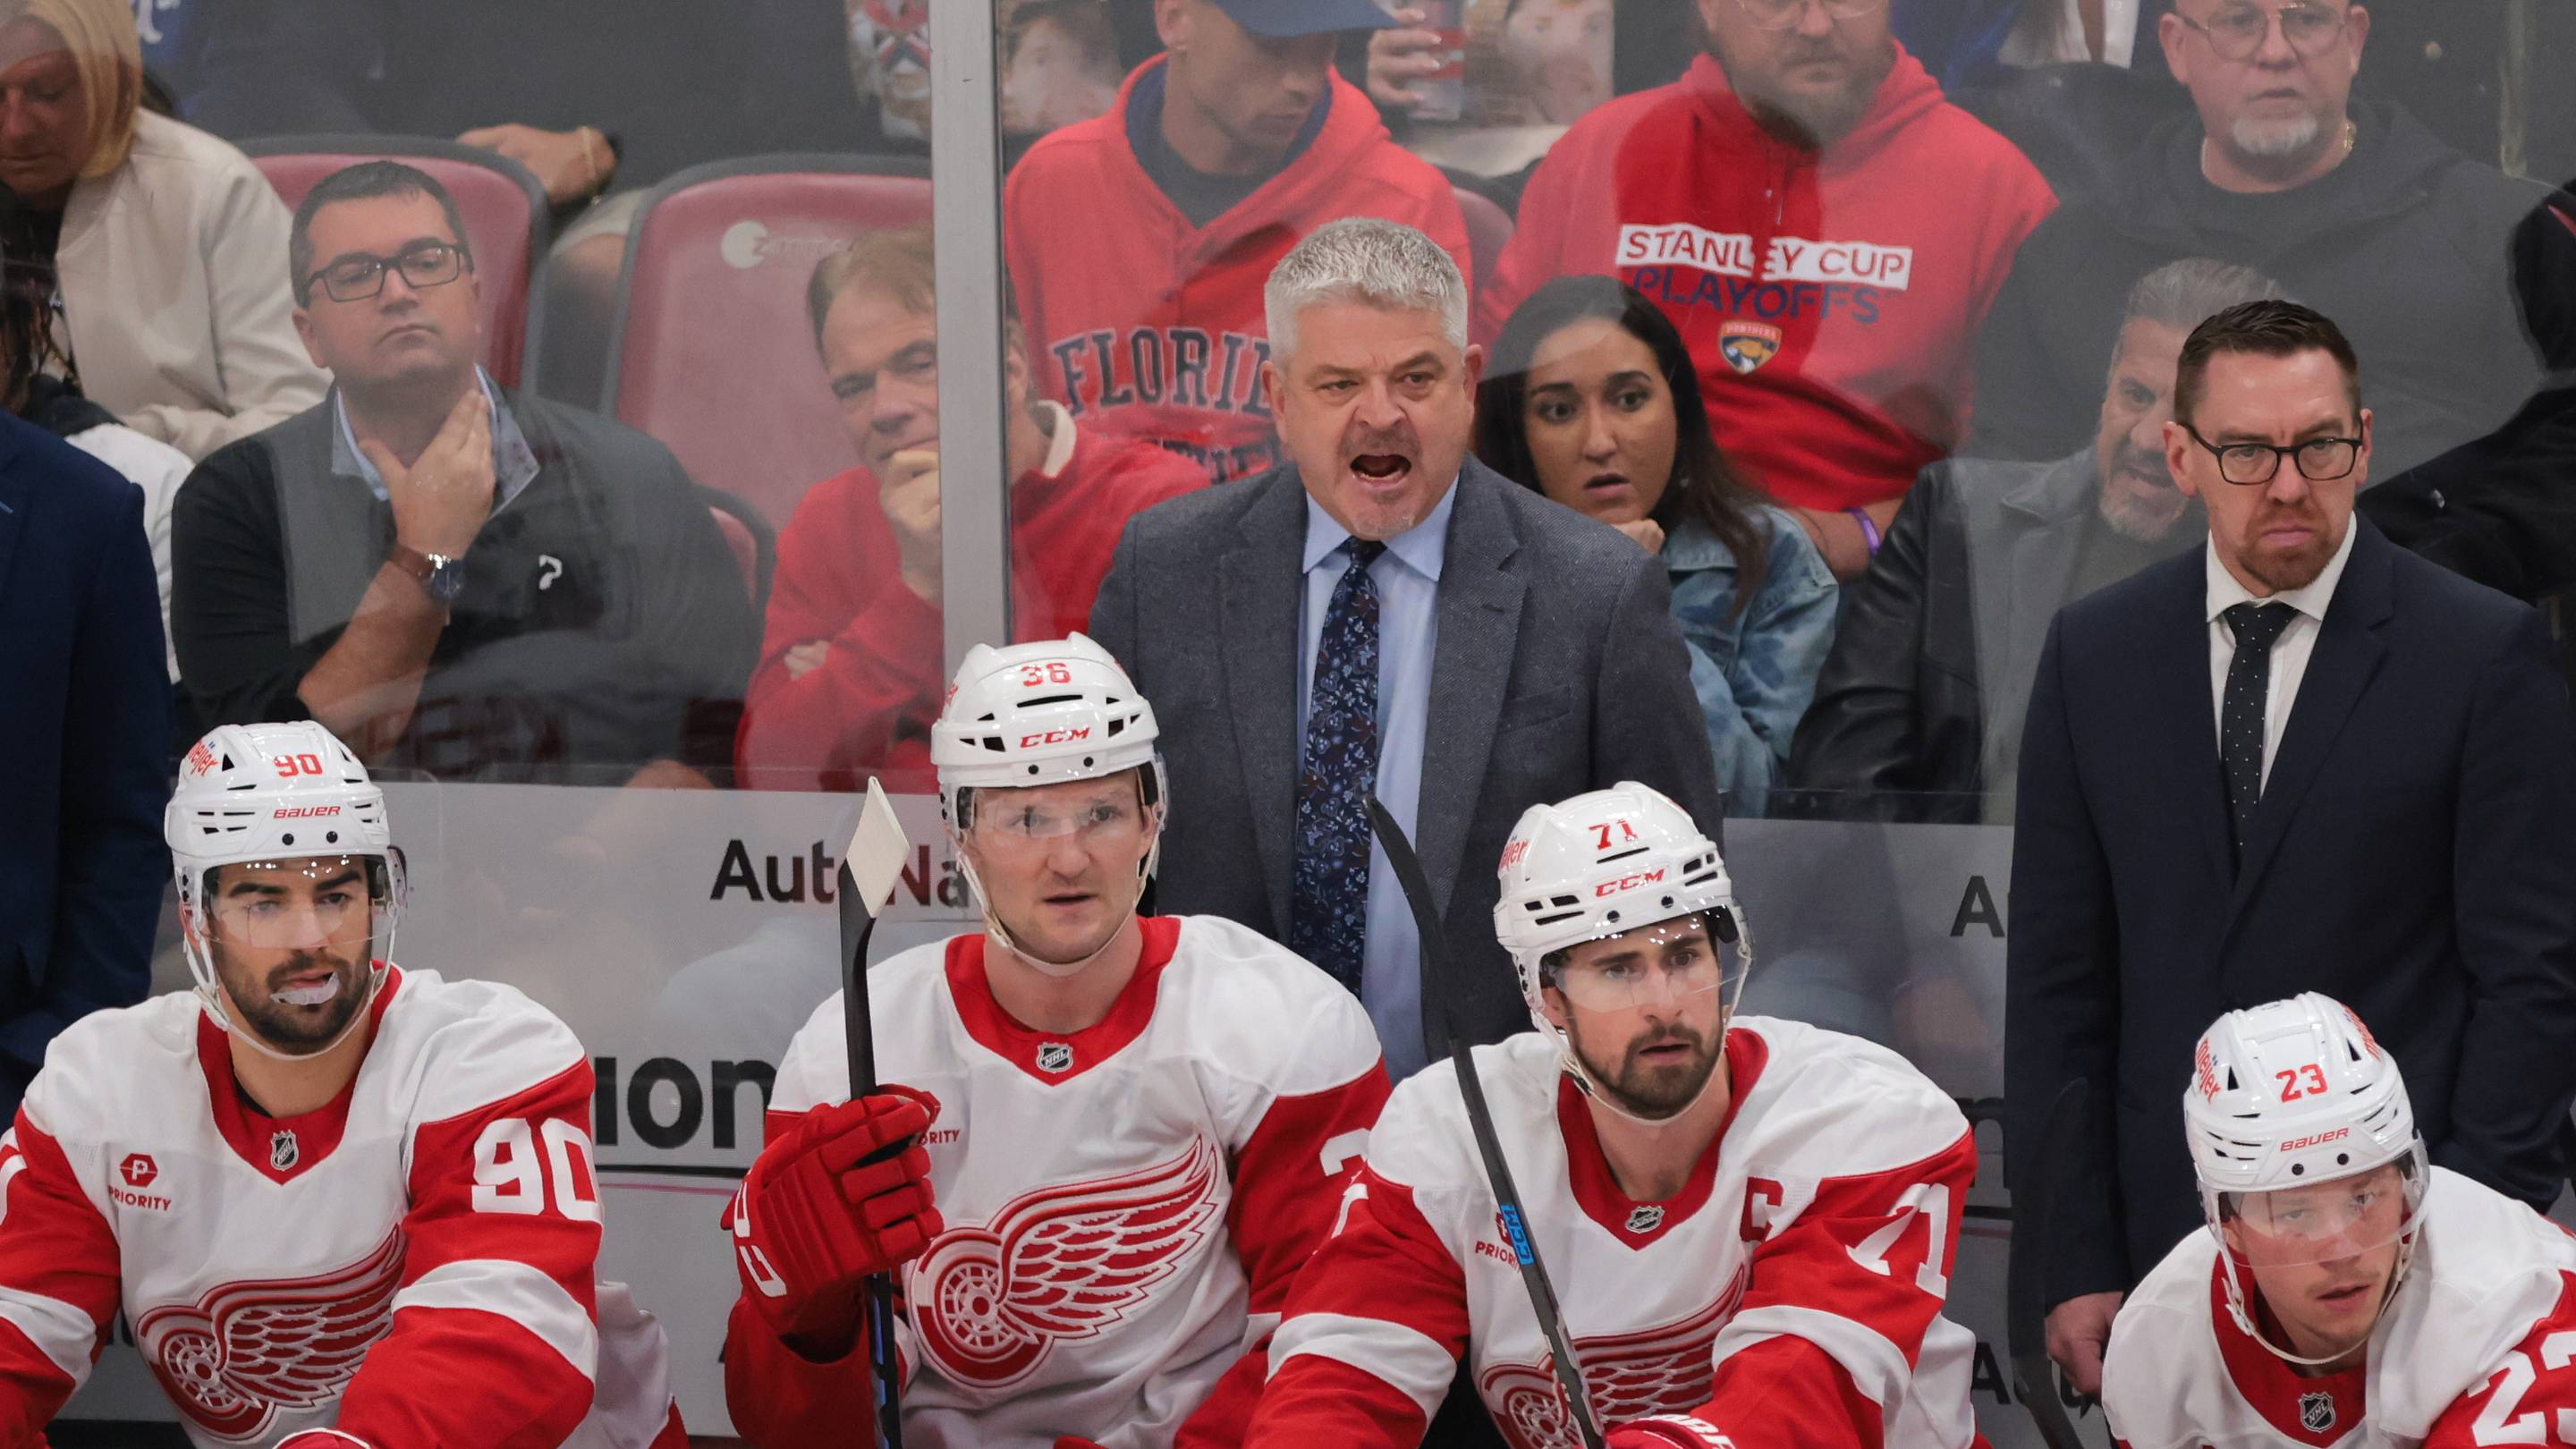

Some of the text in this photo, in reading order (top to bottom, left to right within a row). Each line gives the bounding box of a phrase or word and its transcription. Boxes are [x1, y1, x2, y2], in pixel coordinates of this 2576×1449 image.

[1819, 248, 1904, 281] CUP
[1633, 267, 1879, 324] PLAYOFFS
[1021, 662, 1072, 687] 36
[1020, 727, 1090, 749] CCM
[273, 753, 324, 778] 90
[273, 806, 341, 819] BAUER
[1589, 818, 1640, 851] 71
[1595, 869, 1665, 898] CCM
[2275, 1063, 2328, 1103] 23
[2281, 1128, 2350, 1152] BAUER
[471, 1117, 604, 1225] 90
[107, 1185, 172, 1211] PRIORITY
[1740, 1176, 1784, 1242] C
[1503, 1208, 1530, 1260] CCM
[1845, 1182, 1950, 1301] 71
